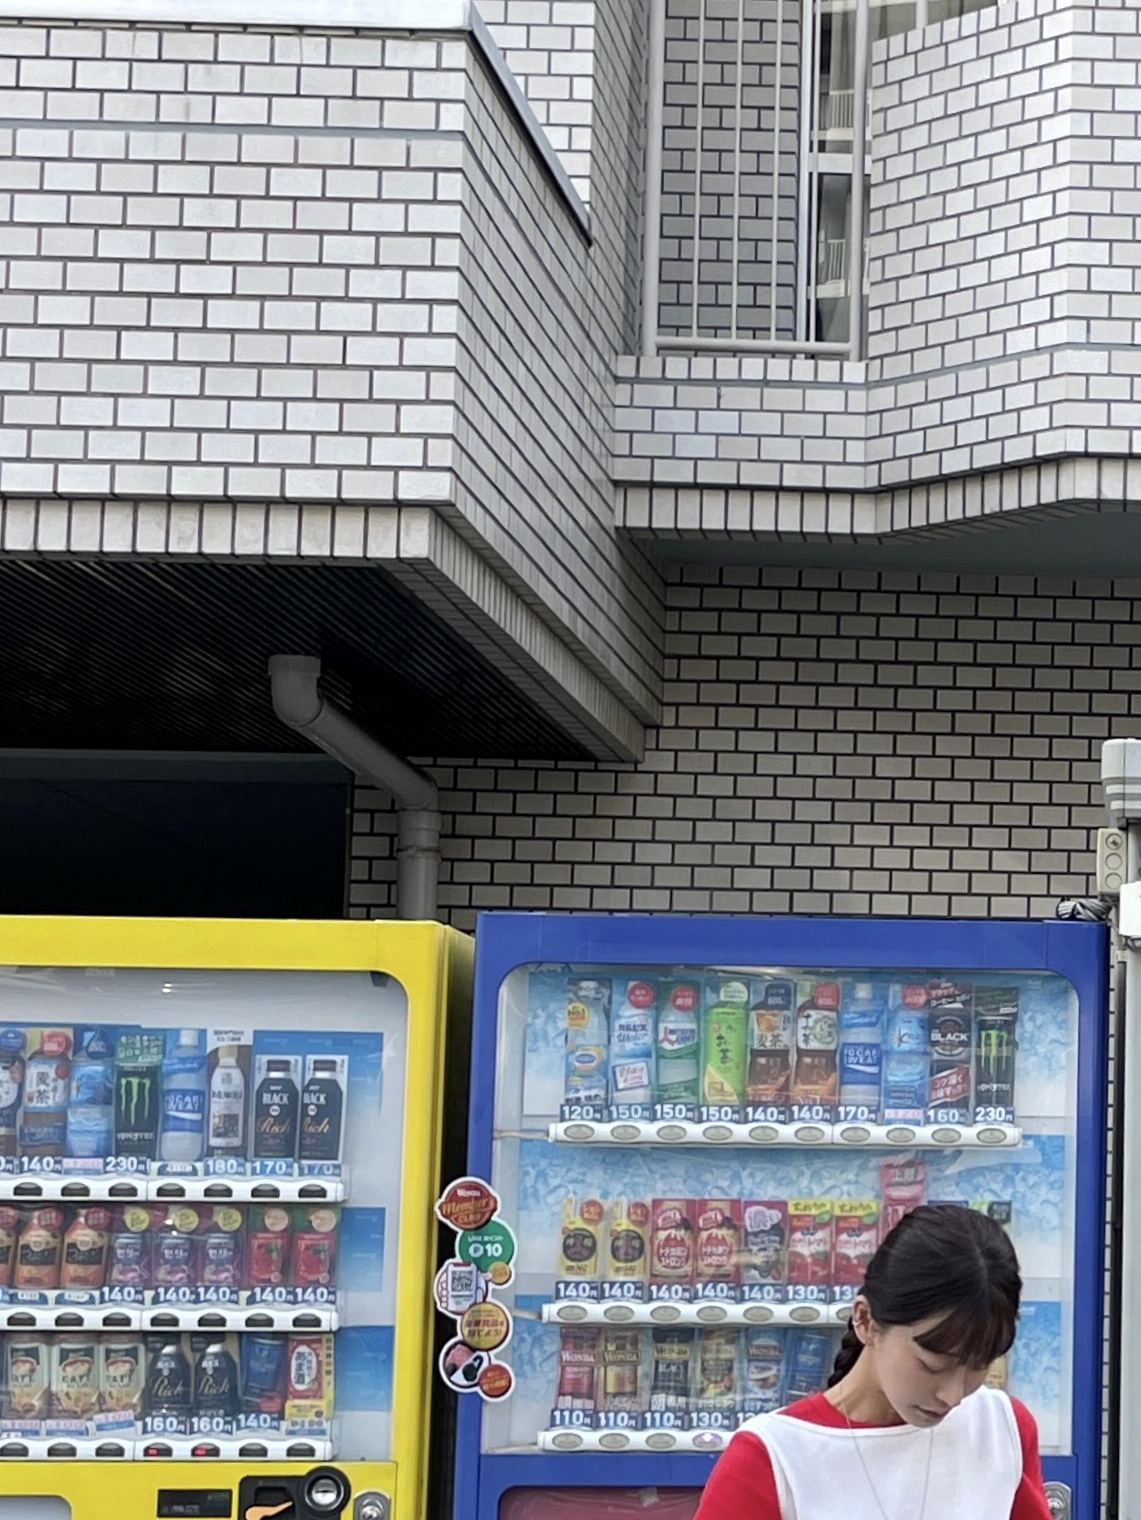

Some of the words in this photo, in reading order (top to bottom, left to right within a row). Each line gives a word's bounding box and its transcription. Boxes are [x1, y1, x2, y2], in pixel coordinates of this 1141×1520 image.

[930, 1032, 968, 1042] BLACK
[561, 1350, 595, 1362] WONDA
[603, 1350, 640, 1362] WONDA
